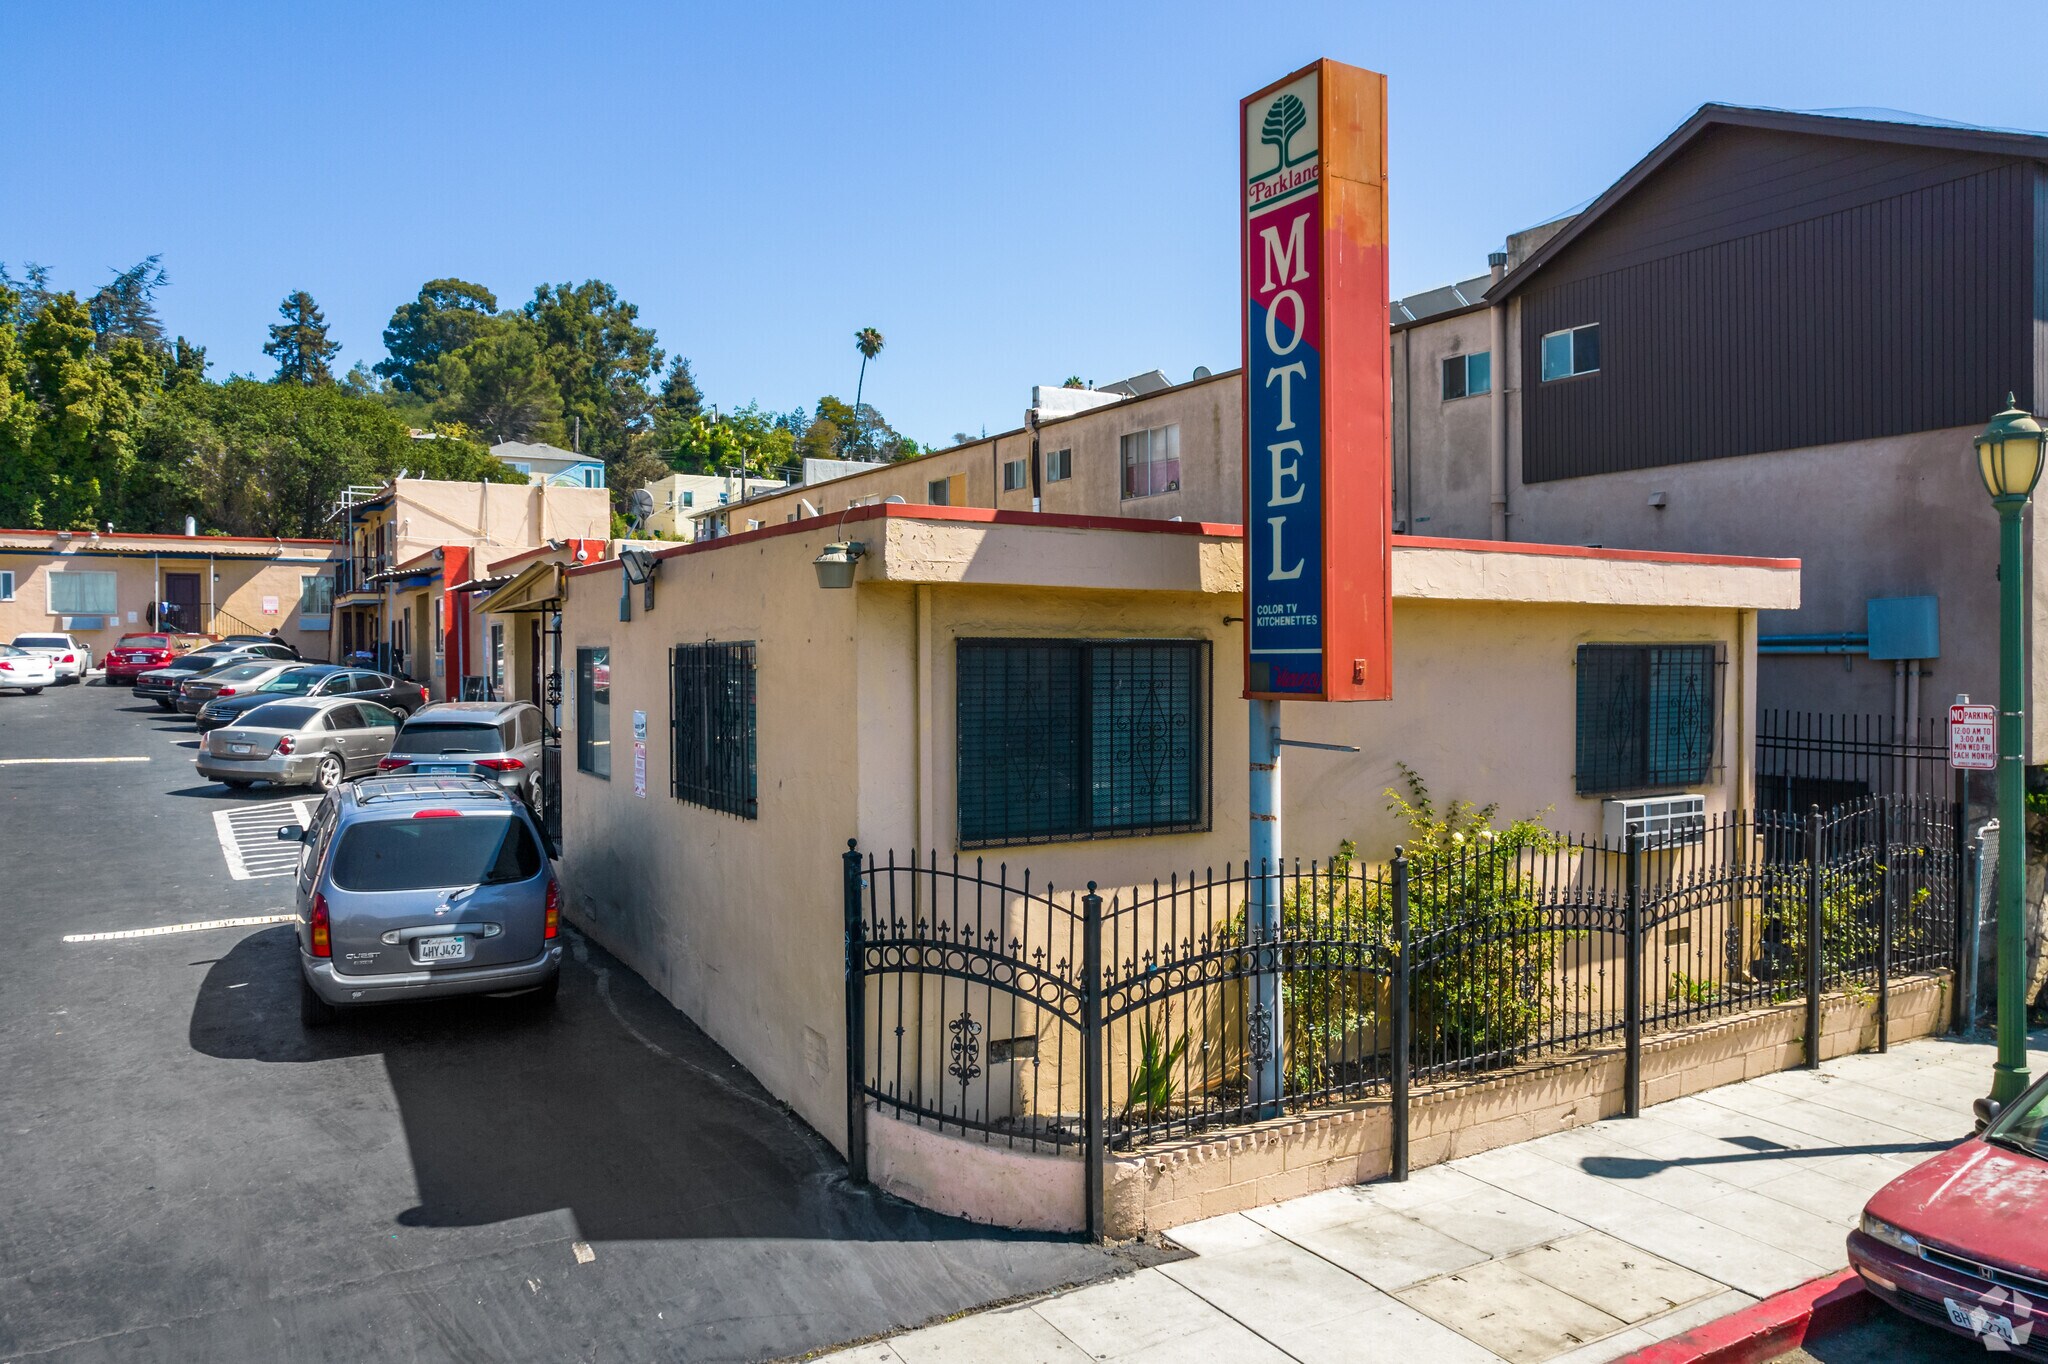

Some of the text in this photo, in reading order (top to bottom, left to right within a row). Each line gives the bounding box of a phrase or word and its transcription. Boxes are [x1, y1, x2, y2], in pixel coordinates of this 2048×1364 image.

[1249, 164, 1319, 203] Parklane
[1260, 212, 1311, 581] MOTEL
[1257, 603, 1298, 615] COLOR TV
[1257, 615, 1318, 627] KITCHENETTES
[1952, 710, 1992, 721] NO PARKING
[1954, 727, 1971, 735] 12:00
[1953, 751, 1970, 759] EACH
